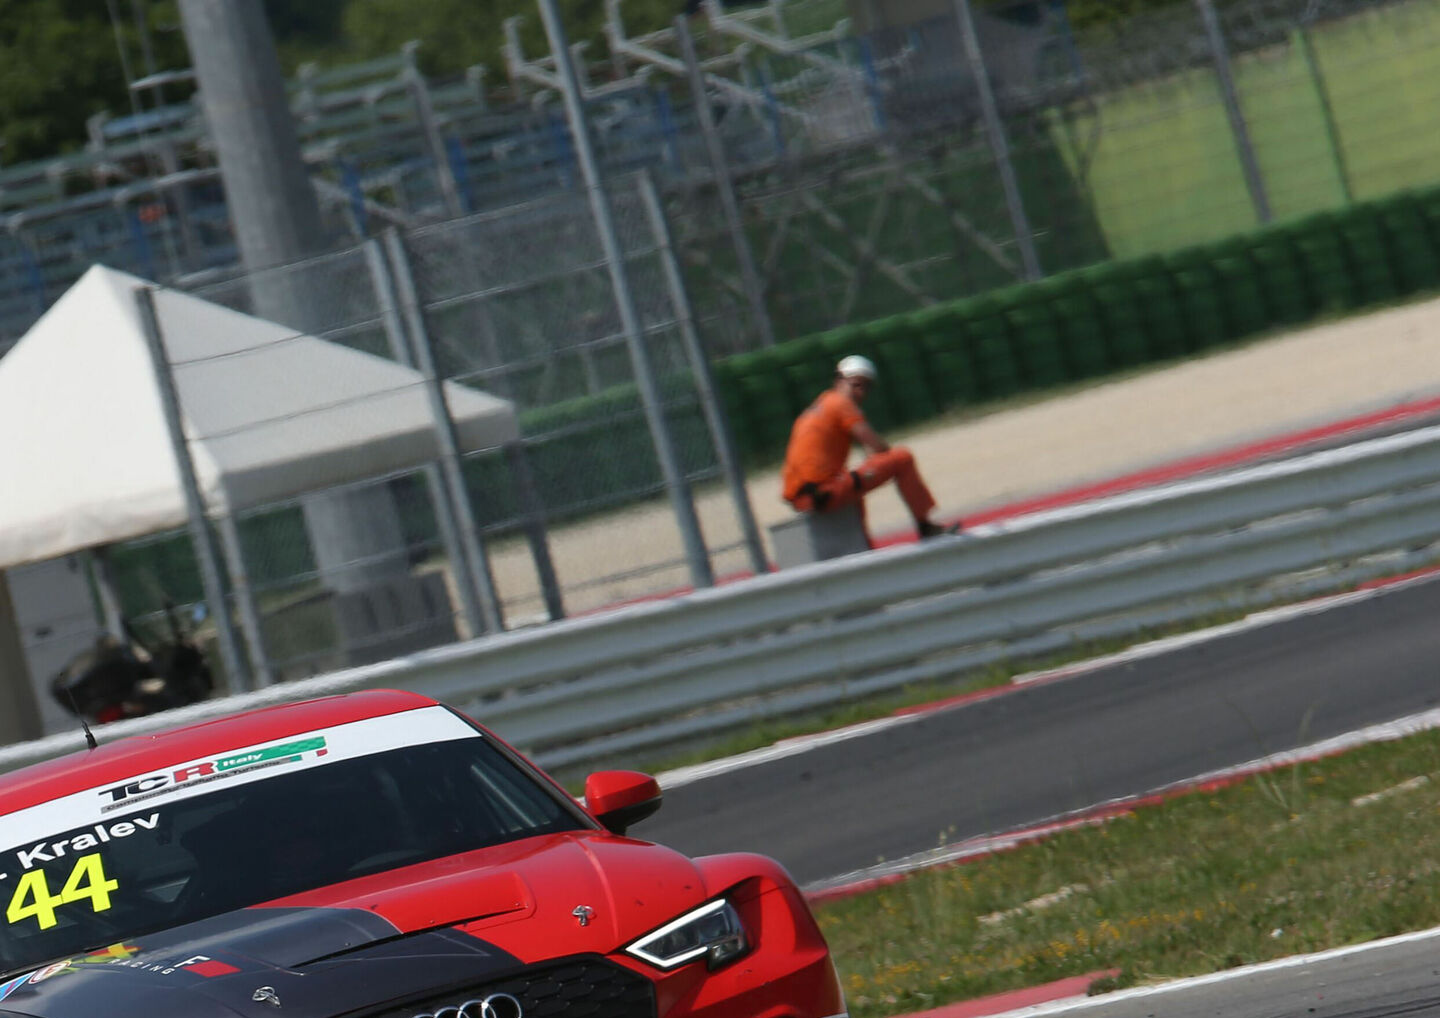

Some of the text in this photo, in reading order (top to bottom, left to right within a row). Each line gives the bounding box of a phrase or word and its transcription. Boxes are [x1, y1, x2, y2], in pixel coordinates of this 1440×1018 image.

[98, 762, 216, 801] TCR
[223, 752, 263, 767] Italy
[17, 813, 160, 869] Kralev
[6, 853, 119, 930] 44
